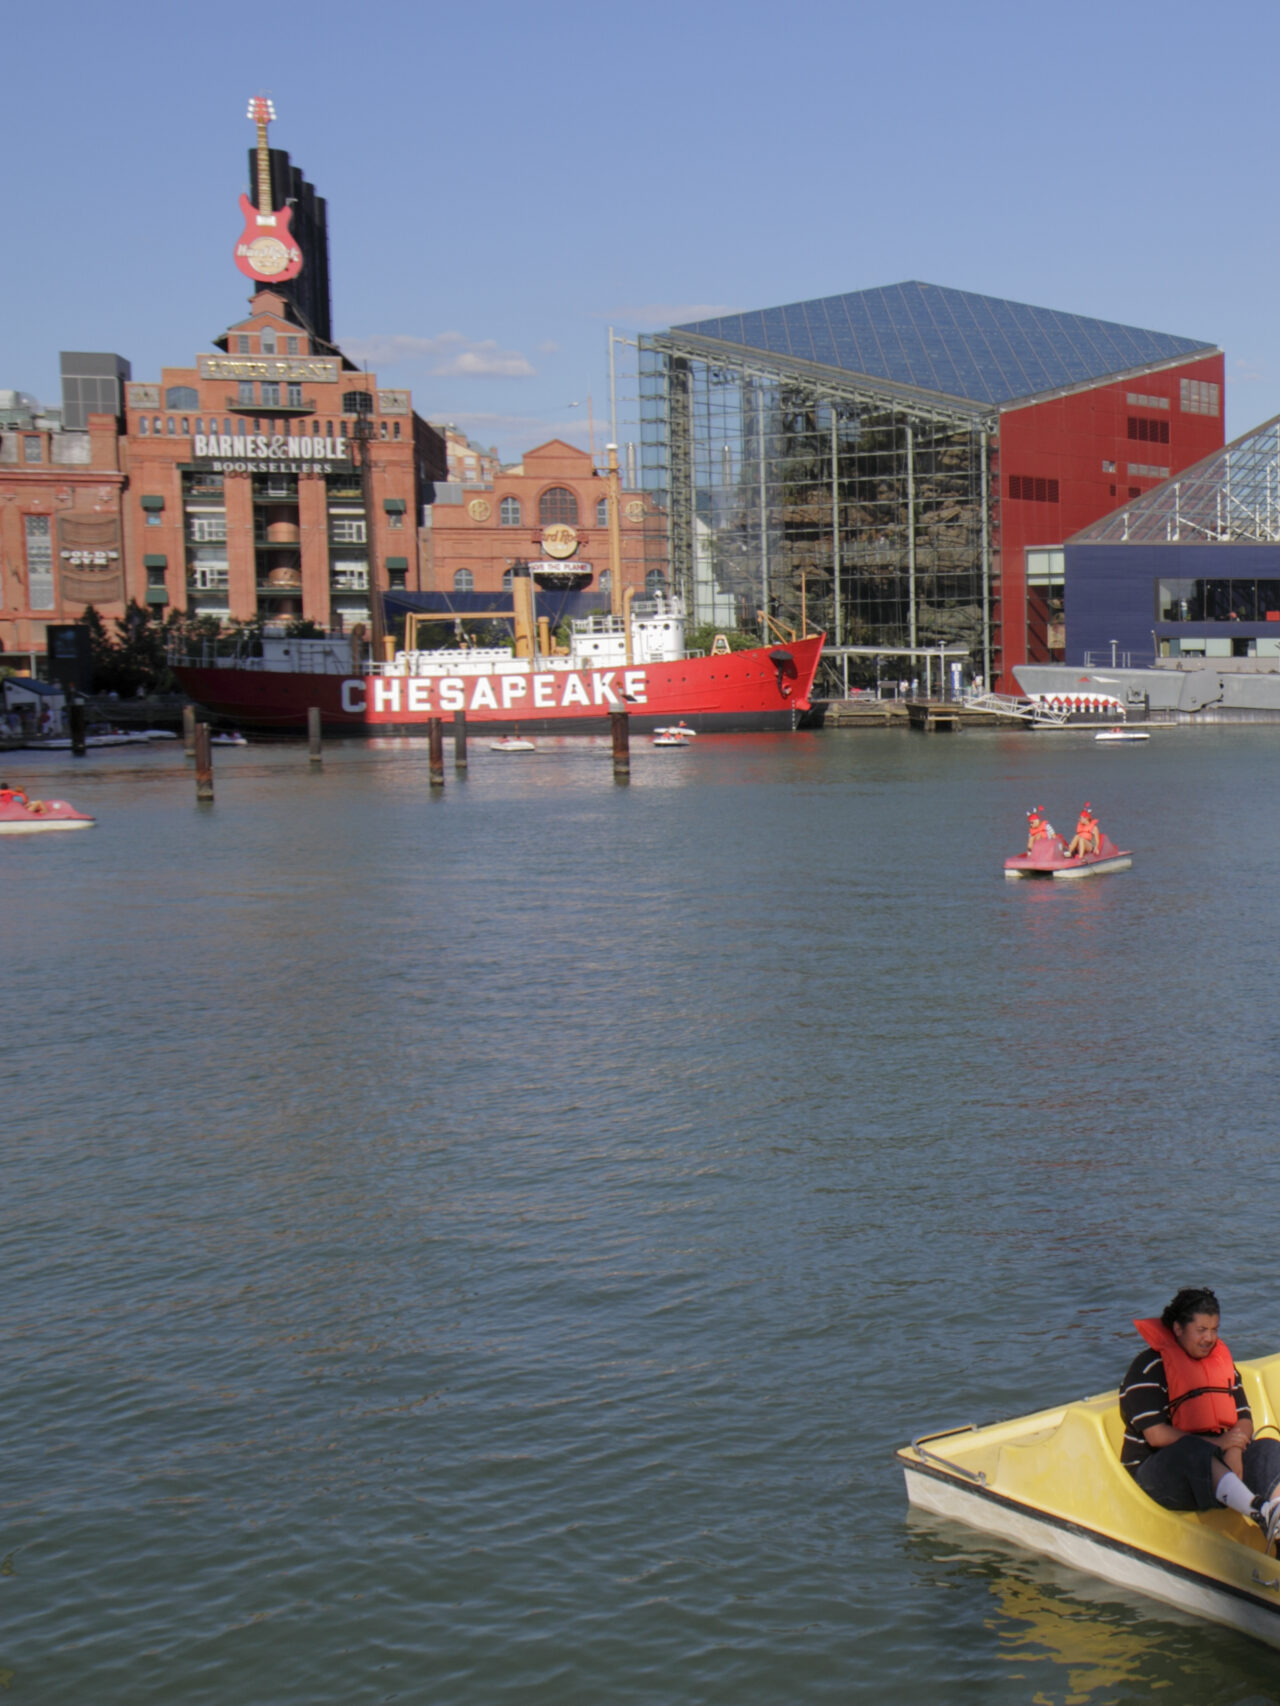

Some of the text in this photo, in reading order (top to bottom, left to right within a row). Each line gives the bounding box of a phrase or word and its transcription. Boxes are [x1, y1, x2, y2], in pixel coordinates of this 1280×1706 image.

[207, 360, 333, 379] POWER PLANT
[212, 461, 332, 474] BOOKSELLERS
[341, 670, 648, 712] CHESAPEAKE
